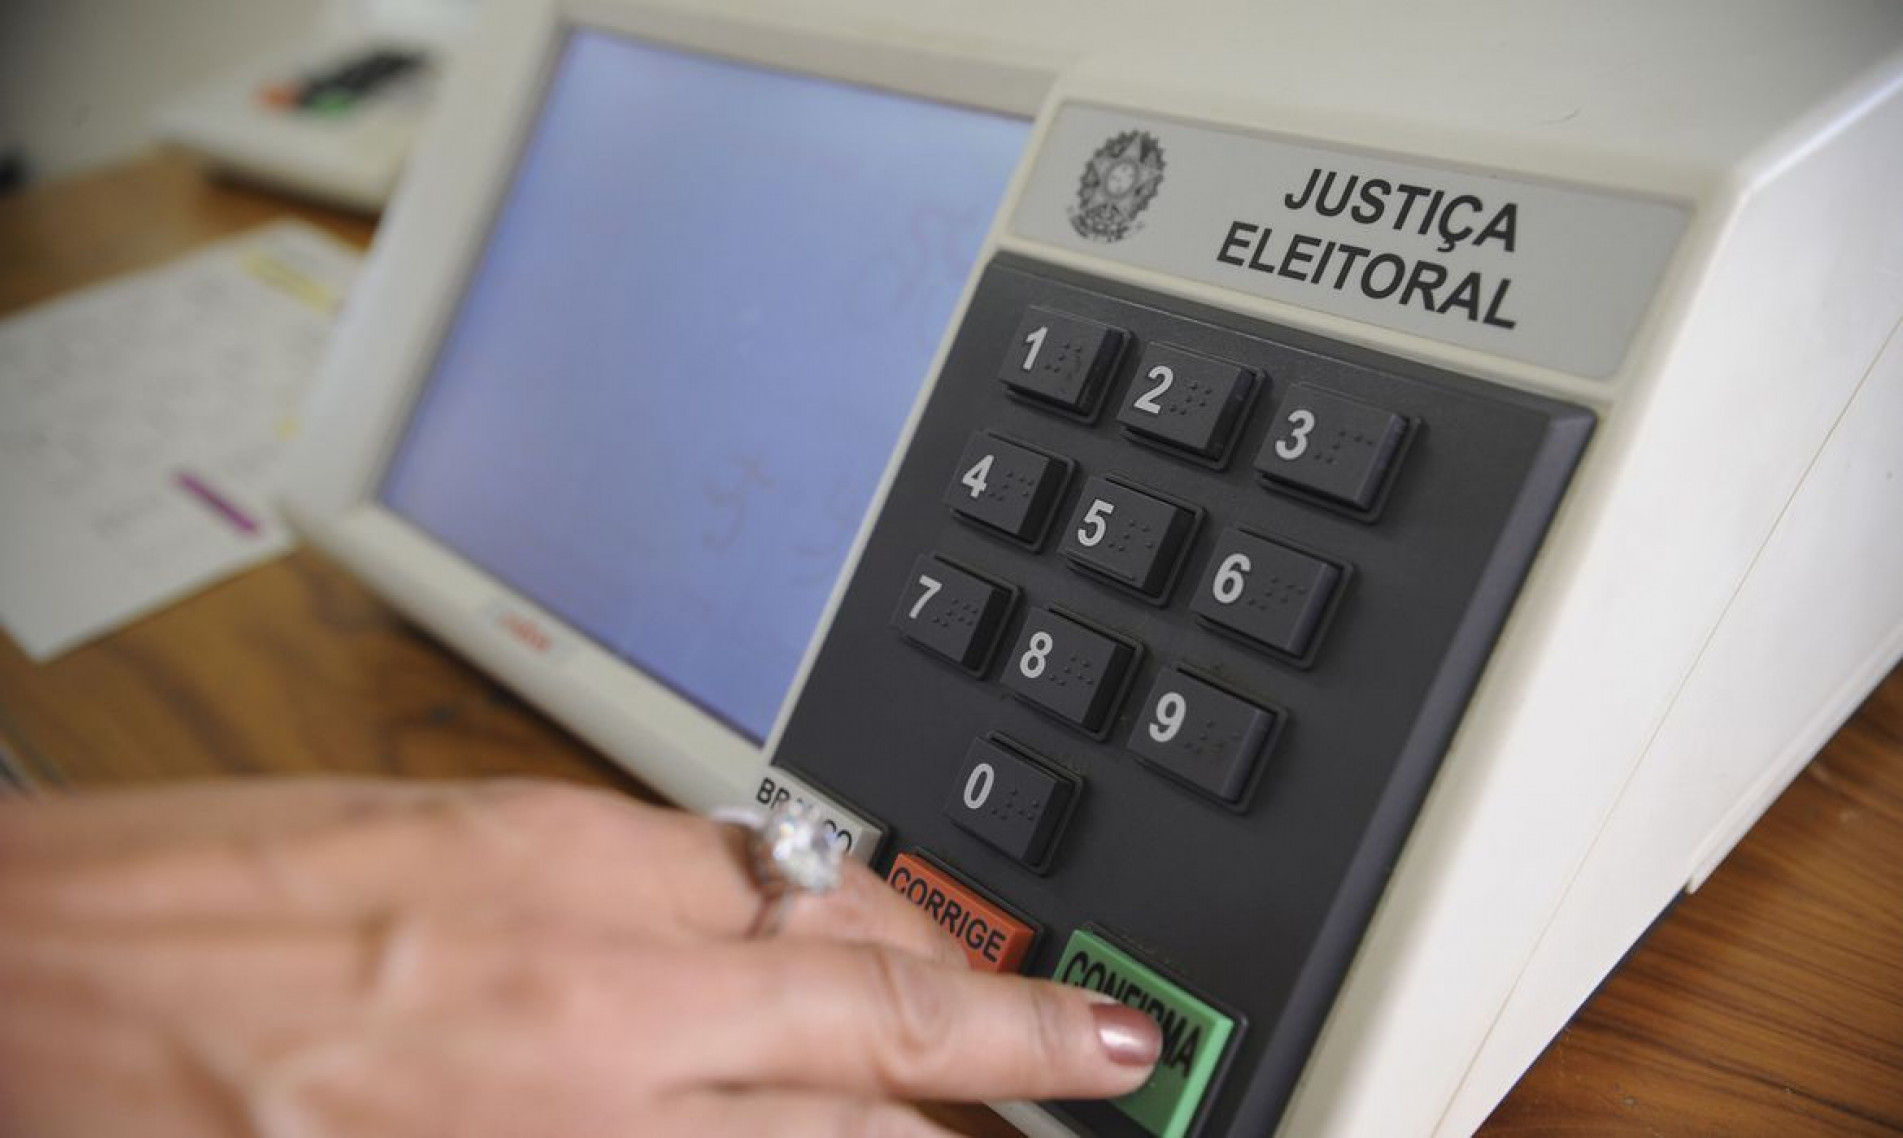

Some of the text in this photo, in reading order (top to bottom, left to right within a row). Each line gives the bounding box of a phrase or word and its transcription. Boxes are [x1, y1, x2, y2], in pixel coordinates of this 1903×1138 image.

[1285, 168, 1518, 253] JUSTIÇA
[1216, 221, 1517, 329] ELEITORAL
[1022, 326, 1048, 370] 1
[1133, 365, 1174, 414] 2
[1275, 409, 1315, 460] 3
[962, 454, 995, 498] 4
[1077, 498, 1115, 547] 5
[909, 574, 943, 619] 7
[1212, 553, 1251, 604] 6
[1019, 631, 1053, 679] 8
[1149, 692, 1187, 743] 9
[963, 763, 995, 809] 0
[757, 776, 853, 855] BRO
[890, 866, 1007, 964] CORRIGE
